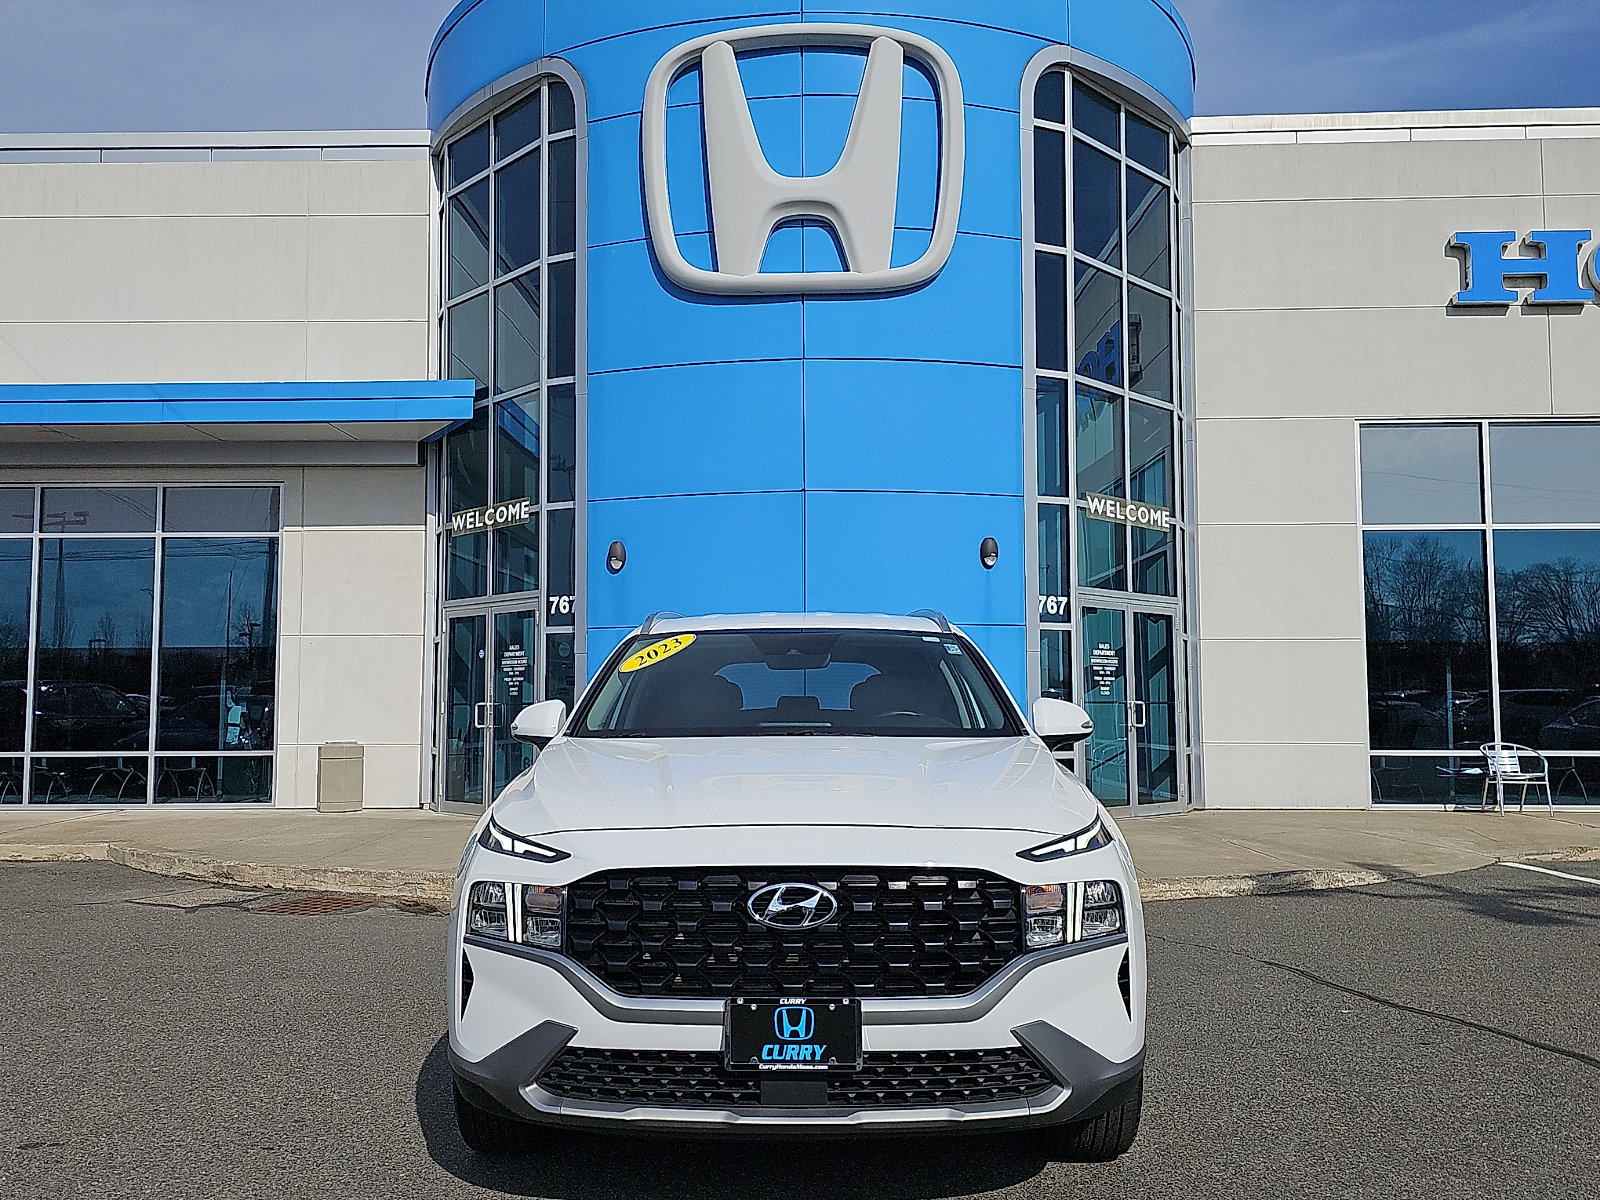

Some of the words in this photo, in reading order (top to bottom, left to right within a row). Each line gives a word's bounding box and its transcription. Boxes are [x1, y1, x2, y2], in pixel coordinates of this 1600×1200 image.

[1446, 229, 1600, 303] H
[452, 500, 531, 532] WELCOME
[1086, 495, 1170, 528] WELCOME
[1038, 595, 1068, 616] 767
[634, 638, 683, 667] 2023
[761, 1044, 828, 1061] CURRY
